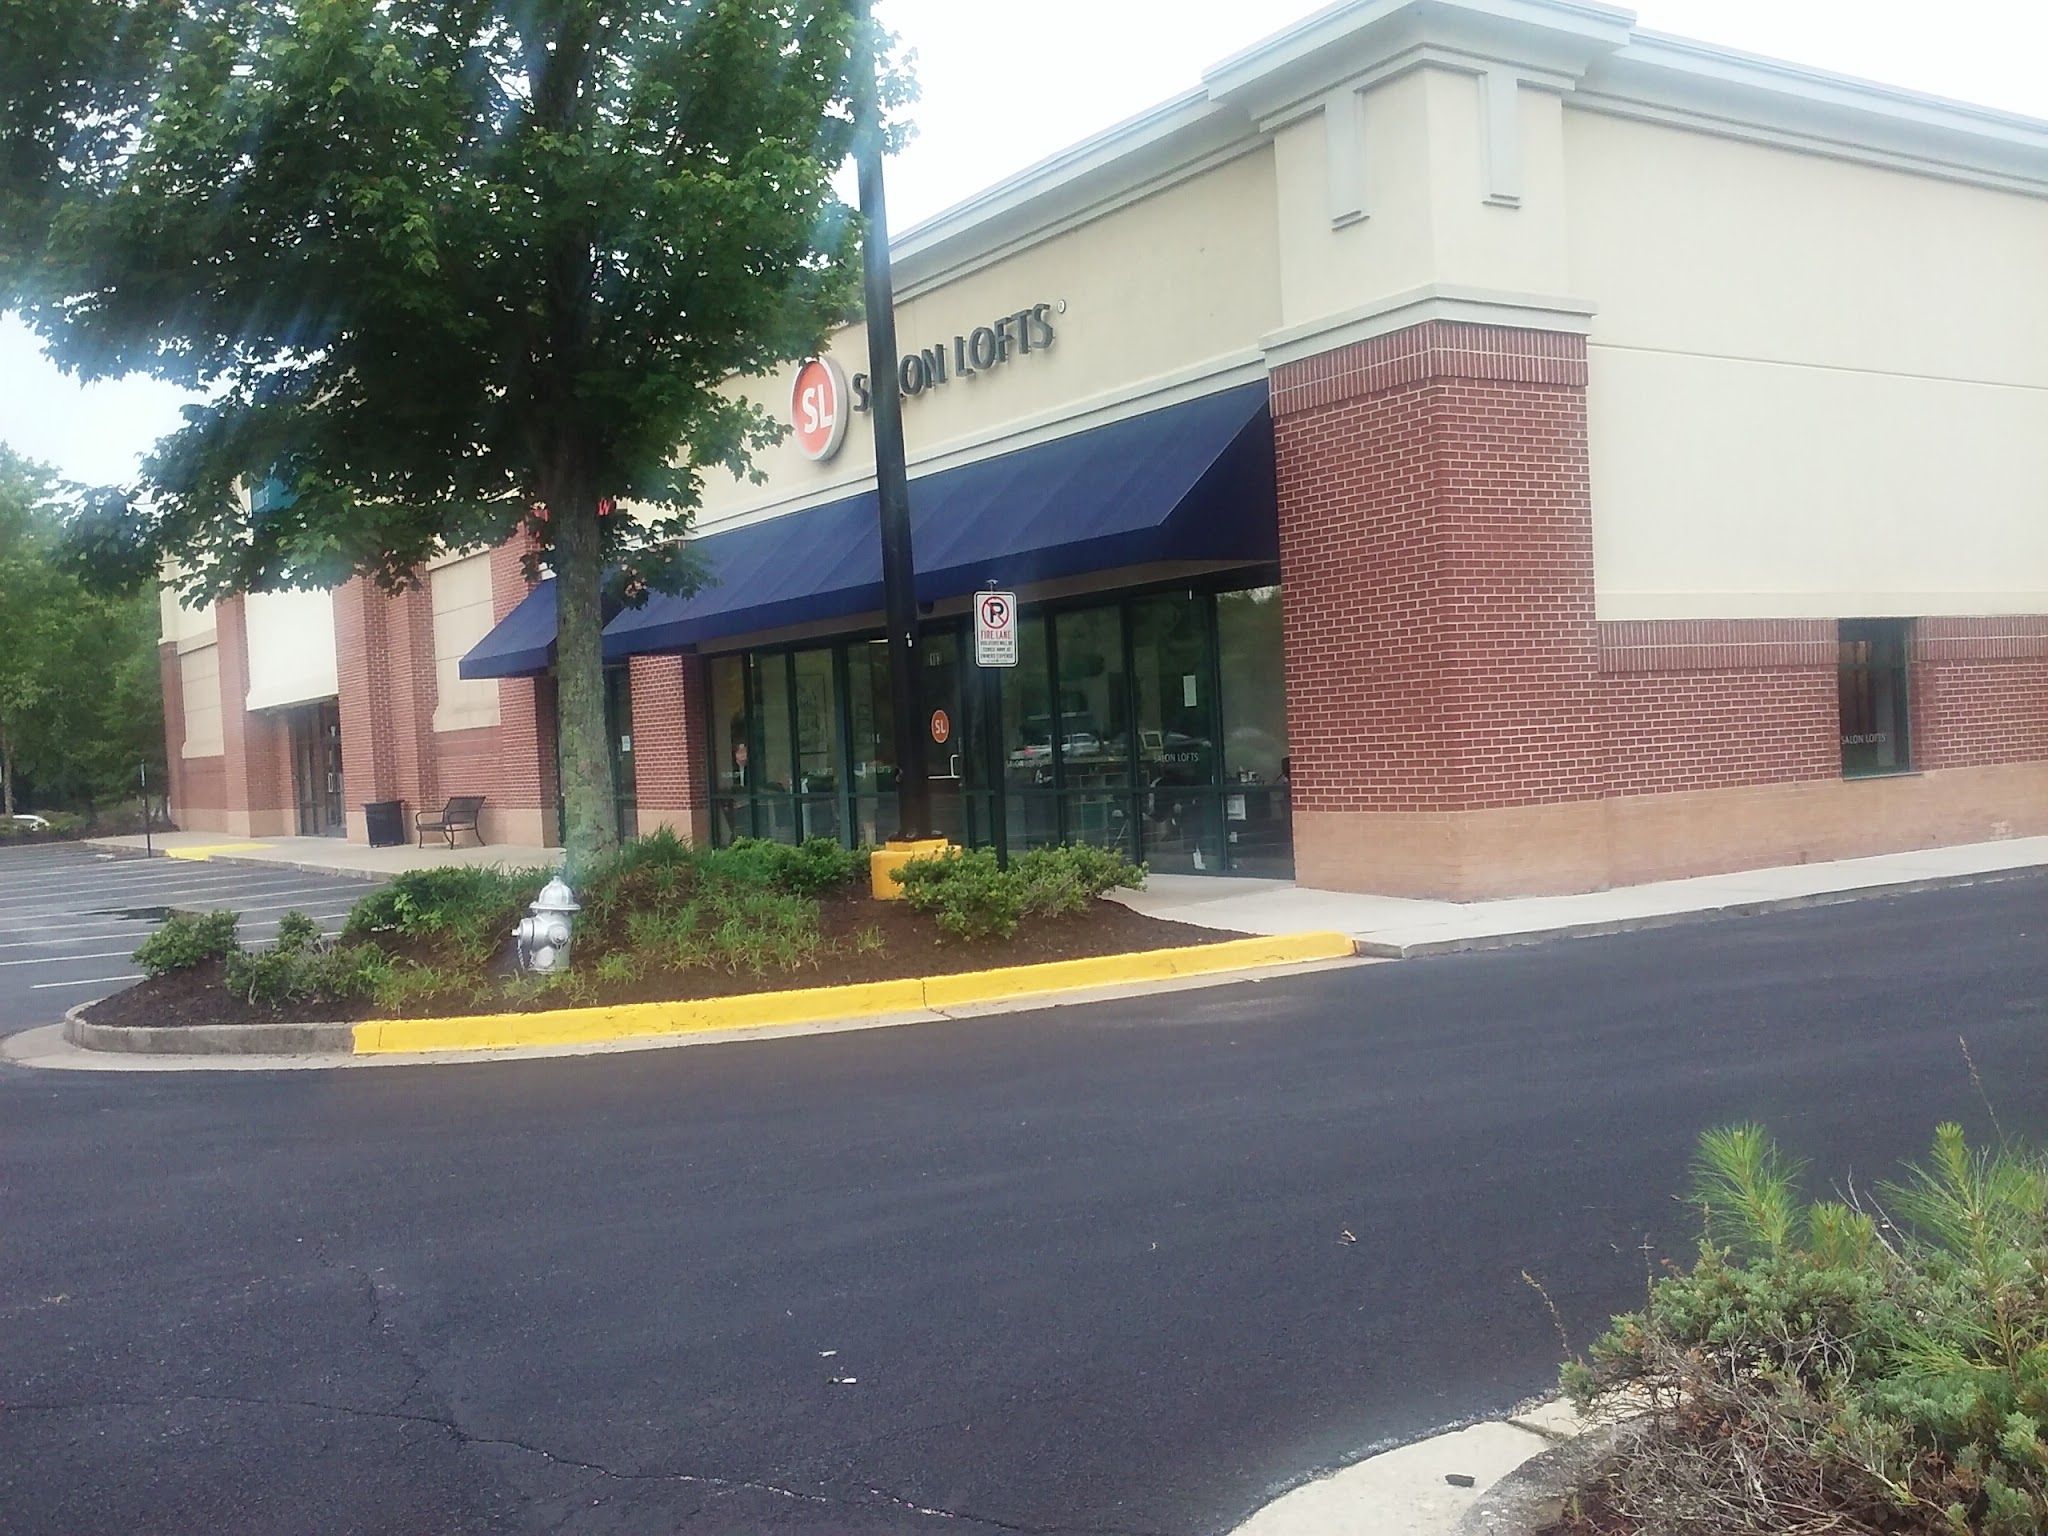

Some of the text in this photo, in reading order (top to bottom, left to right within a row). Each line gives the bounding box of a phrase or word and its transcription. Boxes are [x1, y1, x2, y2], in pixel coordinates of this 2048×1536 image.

[852, 303, 1054, 412] SON LOFTS
[802, 384, 833, 434] SL
[980, 630, 1012, 640] FIRE LANE
[934, 719, 946, 734] SL
[1841, 734, 1864, 745] SALON
[1177, 752, 1199, 762] LOFTS
